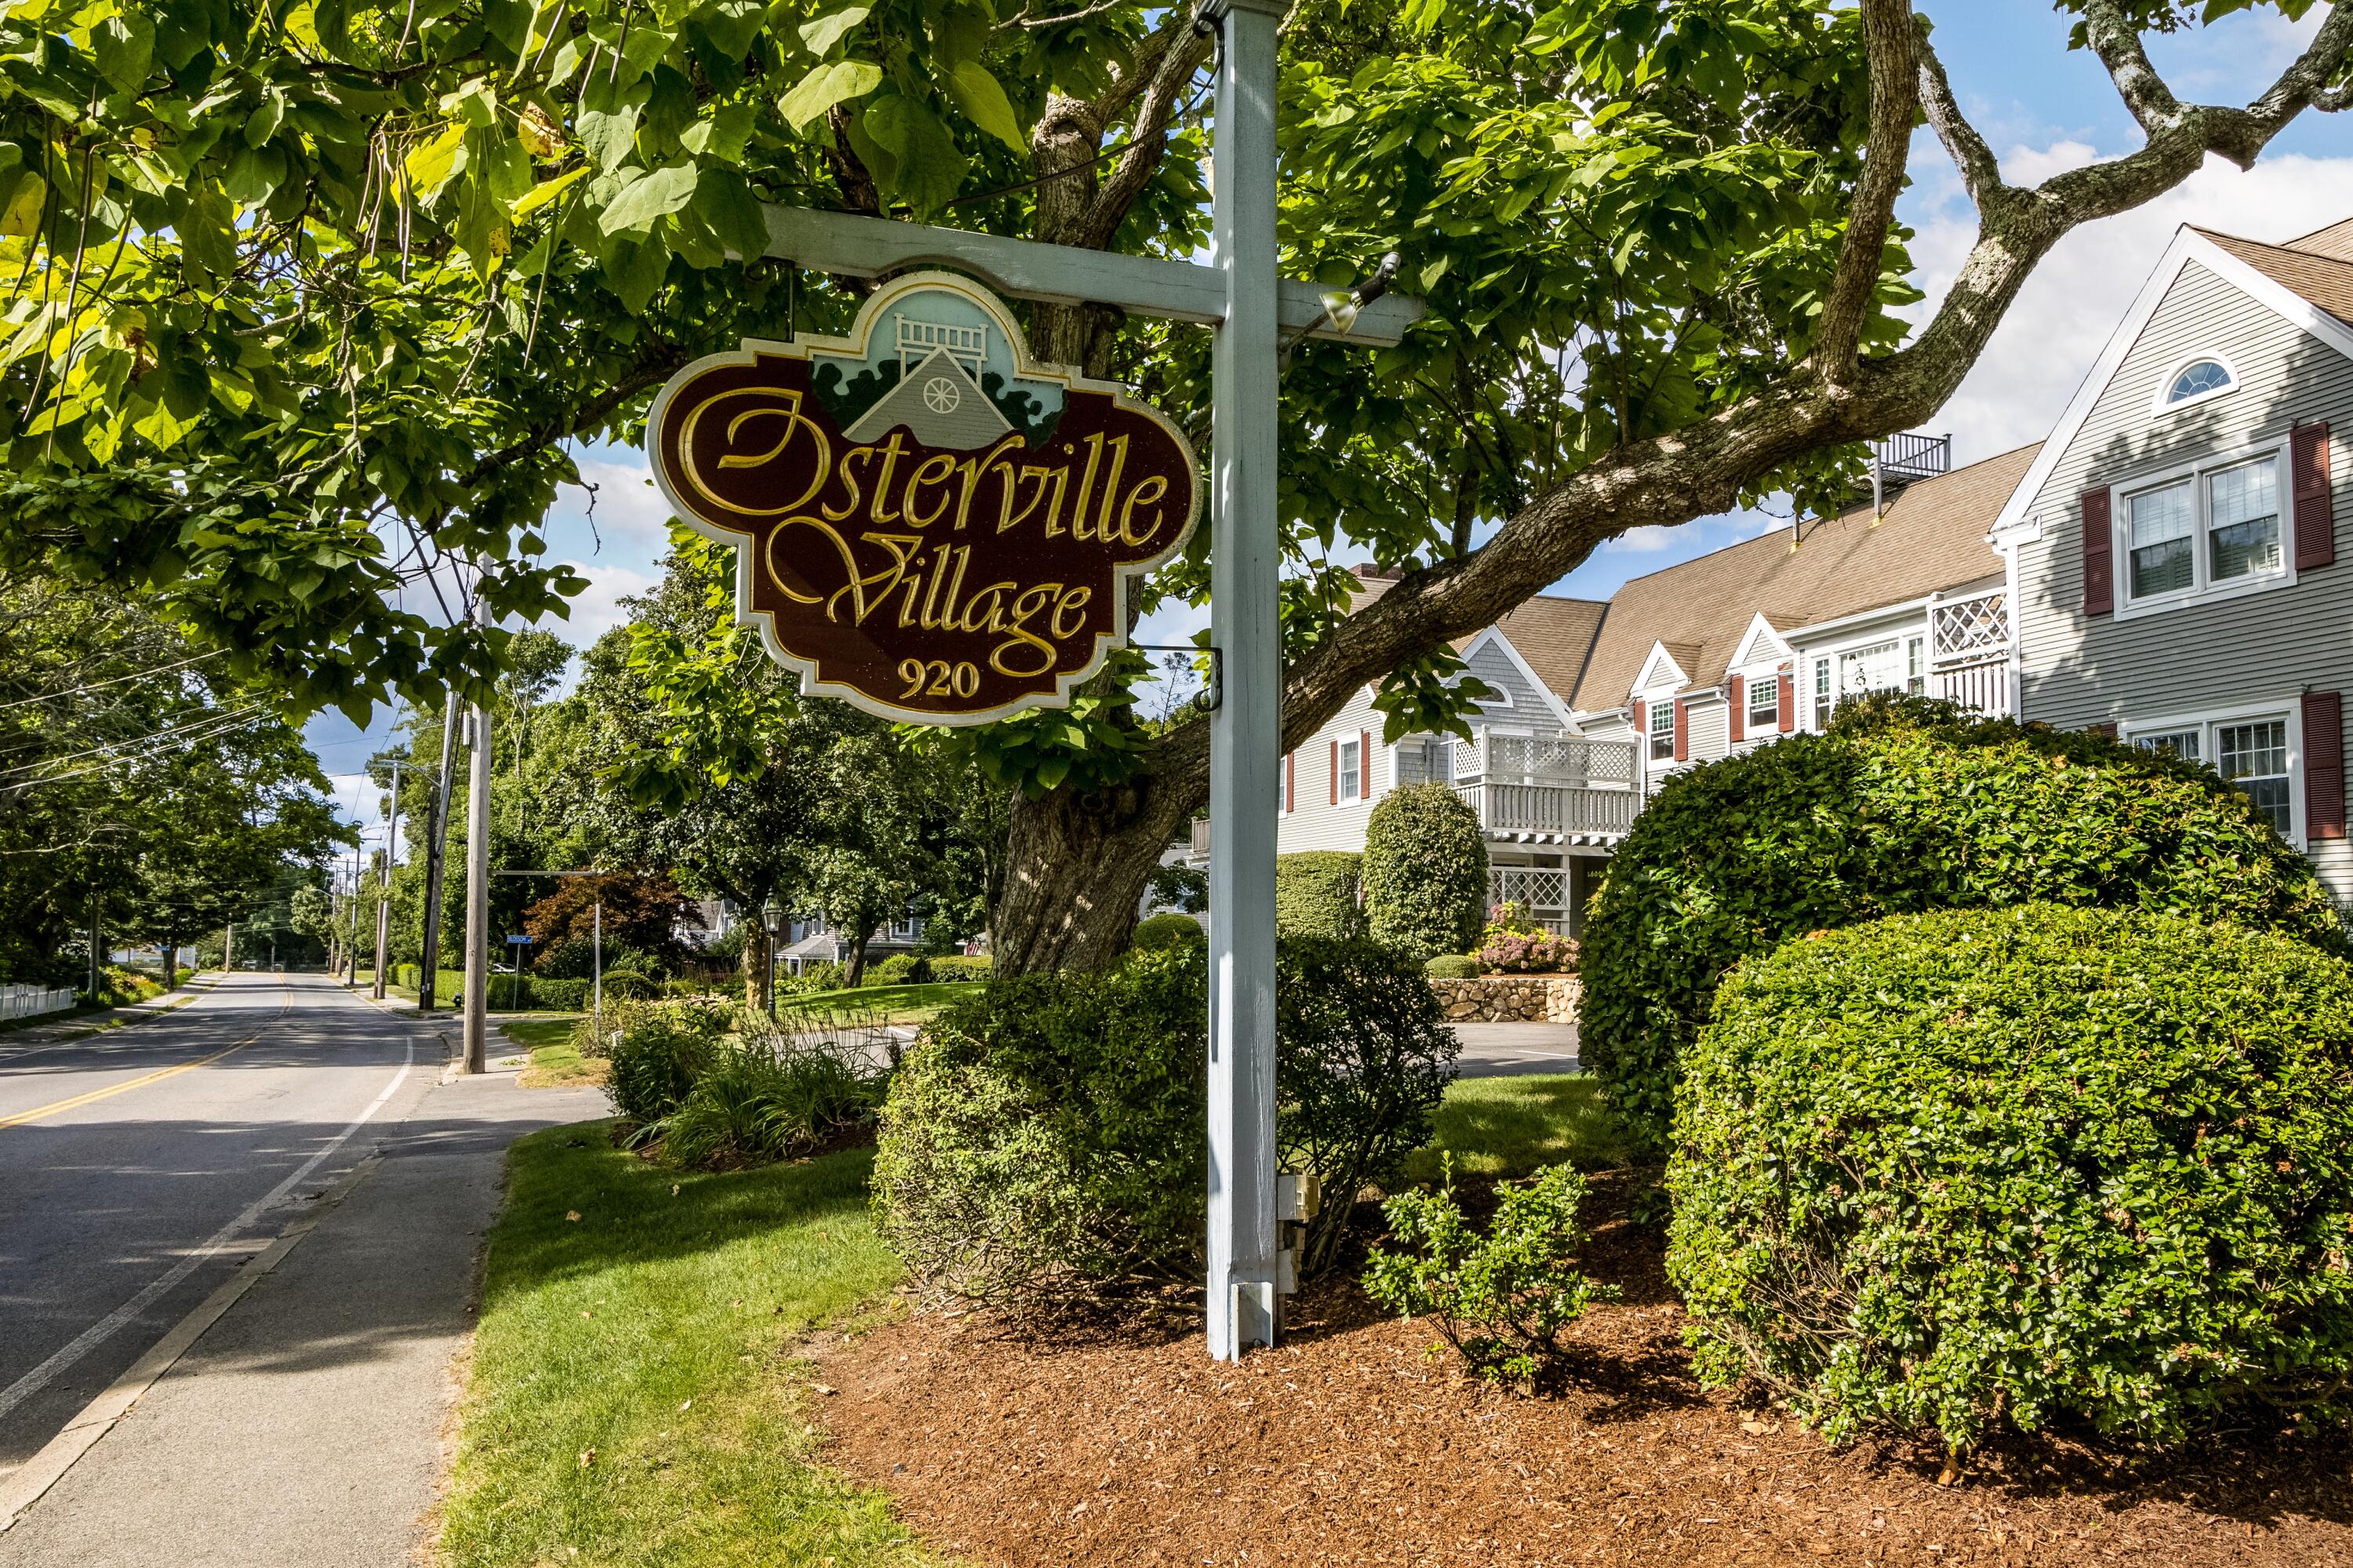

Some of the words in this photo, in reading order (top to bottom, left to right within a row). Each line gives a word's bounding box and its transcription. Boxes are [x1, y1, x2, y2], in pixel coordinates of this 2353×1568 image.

[678, 387, 1168, 547] Osterville
[766, 516, 1091, 677] Village
[898, 659, 980, 699] 920
